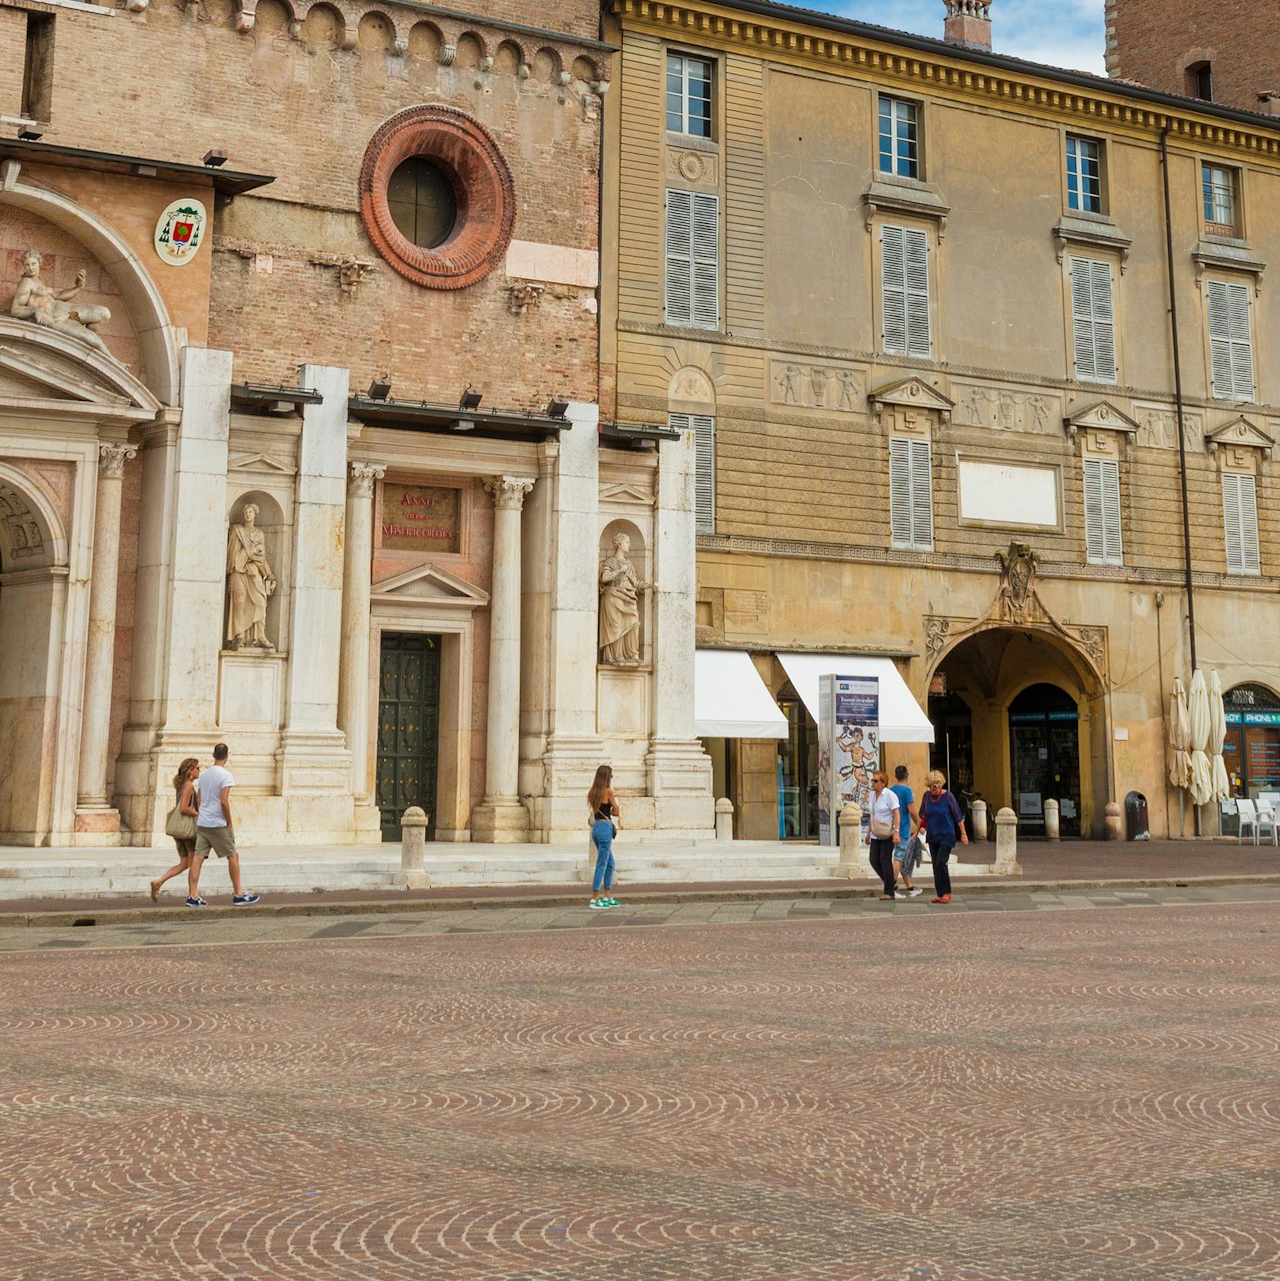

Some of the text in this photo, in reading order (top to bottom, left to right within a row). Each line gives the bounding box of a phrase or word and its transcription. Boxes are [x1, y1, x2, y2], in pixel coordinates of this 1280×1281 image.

[401, 493, 435, 506] ANNO
[382, 523, 452, 539] MISERICORDIA
[1246, 713, 1272, 723] PHONE
